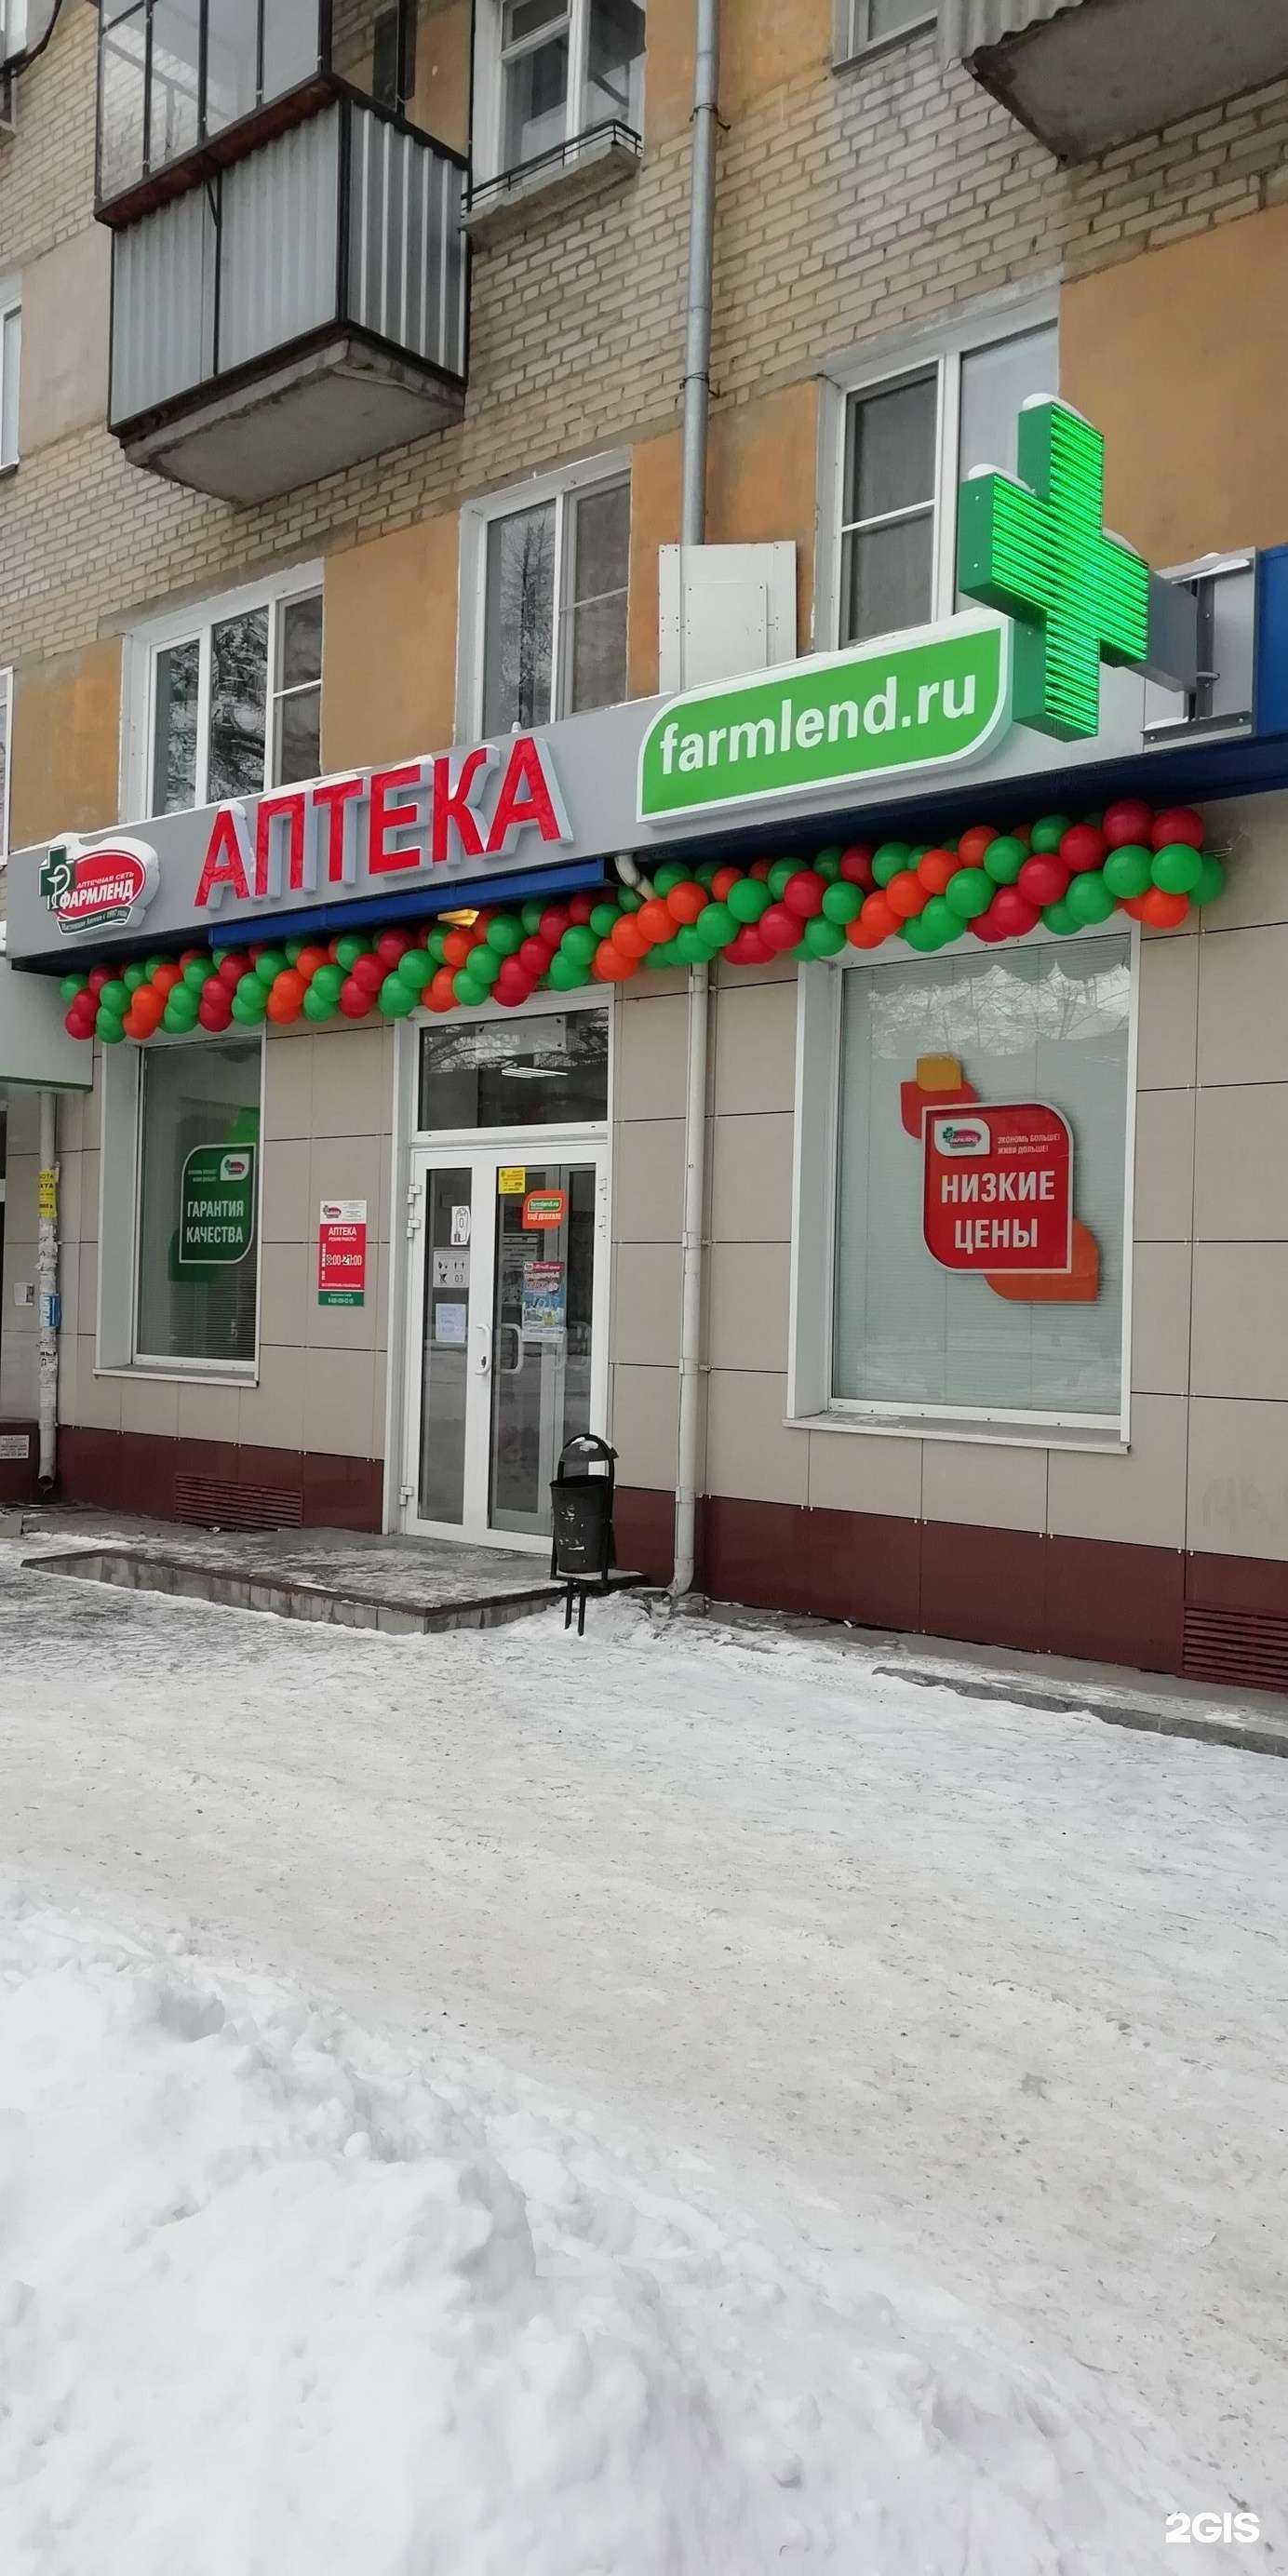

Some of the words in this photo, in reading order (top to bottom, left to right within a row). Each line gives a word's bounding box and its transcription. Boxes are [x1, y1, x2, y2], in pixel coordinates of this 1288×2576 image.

[659, 675, 976, 775] farmlend.ru
[194, 735, 564, 908] АПТЕКА
[59, 879, 134, 909] ФАРМЛЕНД
[76, 875, 114, 889] АПТЕЧНАЯ
[115, 871, 135, 881] СЕТЬ
[941, 1170, 1055, 1203] НИЗКИЕ
[187, 1200, 244, 1217] ГАРАНТИЯ
[186, 1226, 244, 1243] КАЧЕСТВА
[329, 1227, 357, 1236] АПТЕКА
[954, 1218, 1038, 1254] ЦЕНЫ
